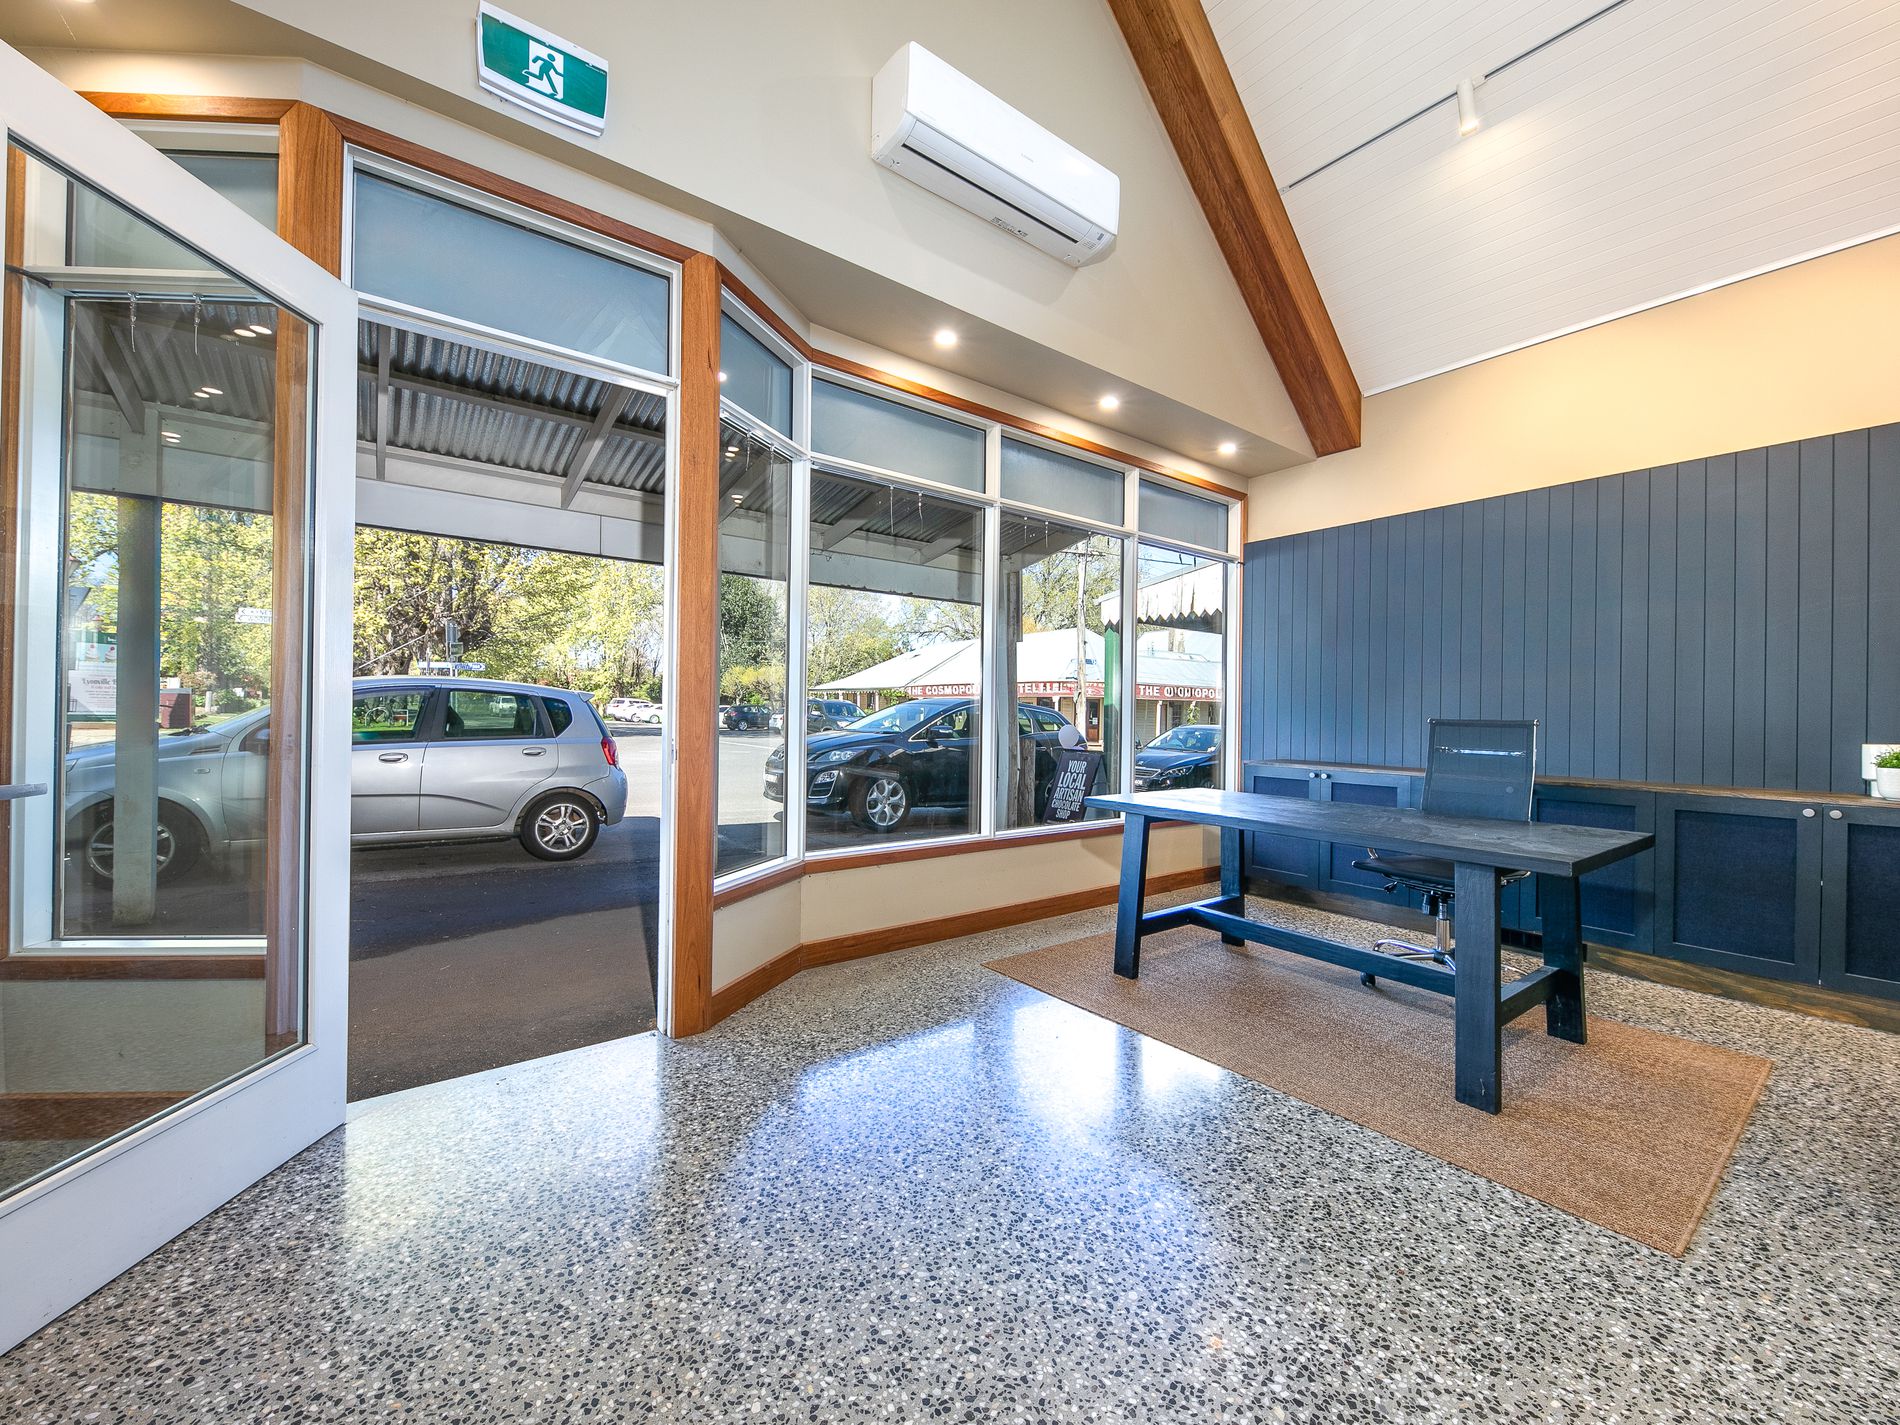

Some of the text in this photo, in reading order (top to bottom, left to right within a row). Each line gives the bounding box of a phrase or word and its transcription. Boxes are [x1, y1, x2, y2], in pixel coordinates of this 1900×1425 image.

[906, 685, 980, 695] THE COSMOPOL
[1018, 682, 1040, 694] TEL
[1139, 685, 1160, 697] THE
[1068, 760, 1087, 773] YOUR
[1058, 772, 1087, 790] LOCAL
[1053, 787, 1085, 802] ARTISAN
[1051, 799, 1081, 812] CHOCOLATE
[1055, 809, 1071, 819] SHOP
